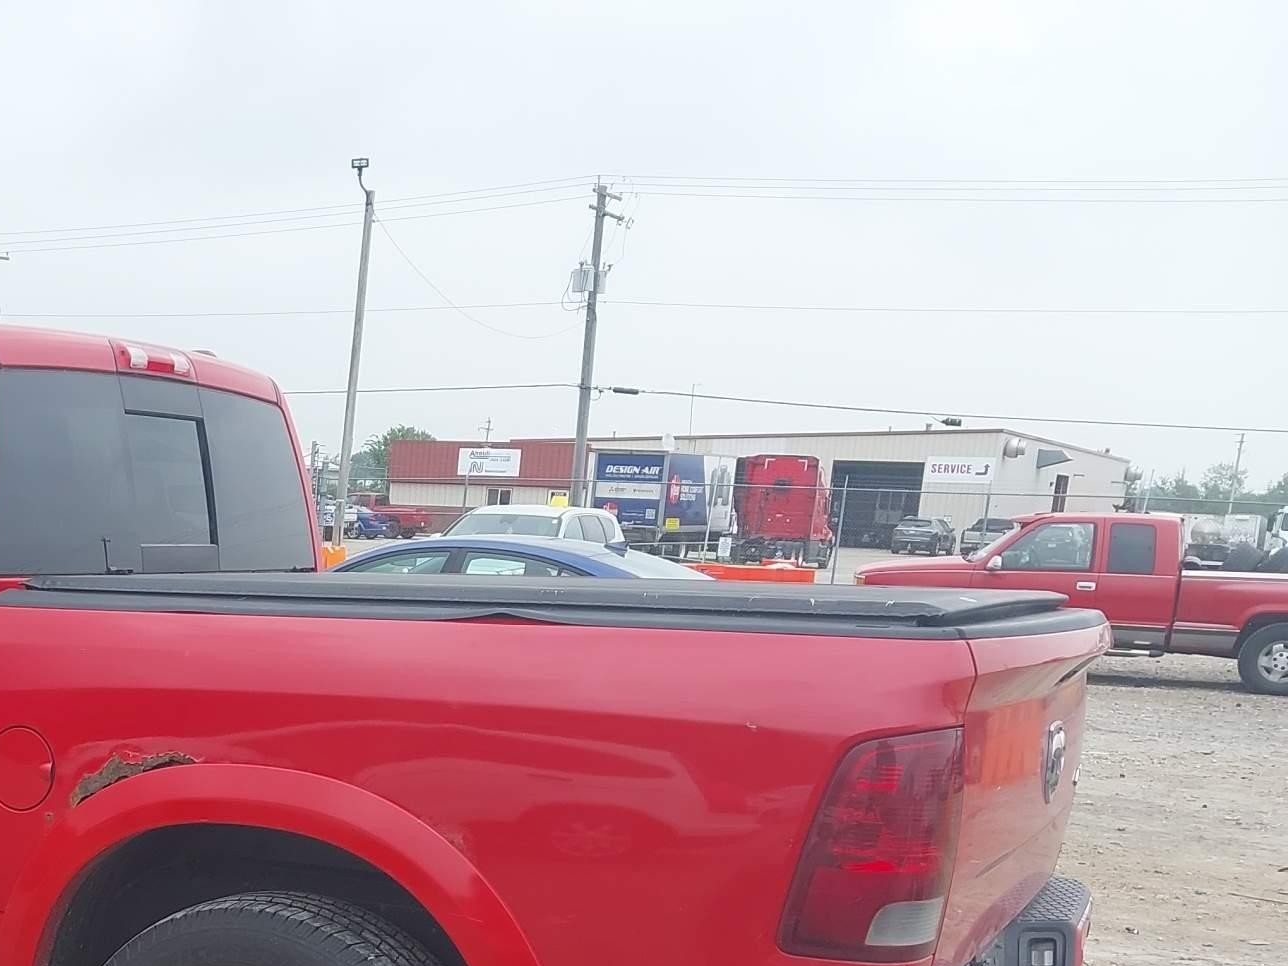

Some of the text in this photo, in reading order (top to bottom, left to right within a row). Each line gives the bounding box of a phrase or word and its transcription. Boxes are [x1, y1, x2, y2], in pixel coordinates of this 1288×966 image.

[606, 465, 660, 475] DESIGN AIR
[931, 463, 973, 474] SERVICE
